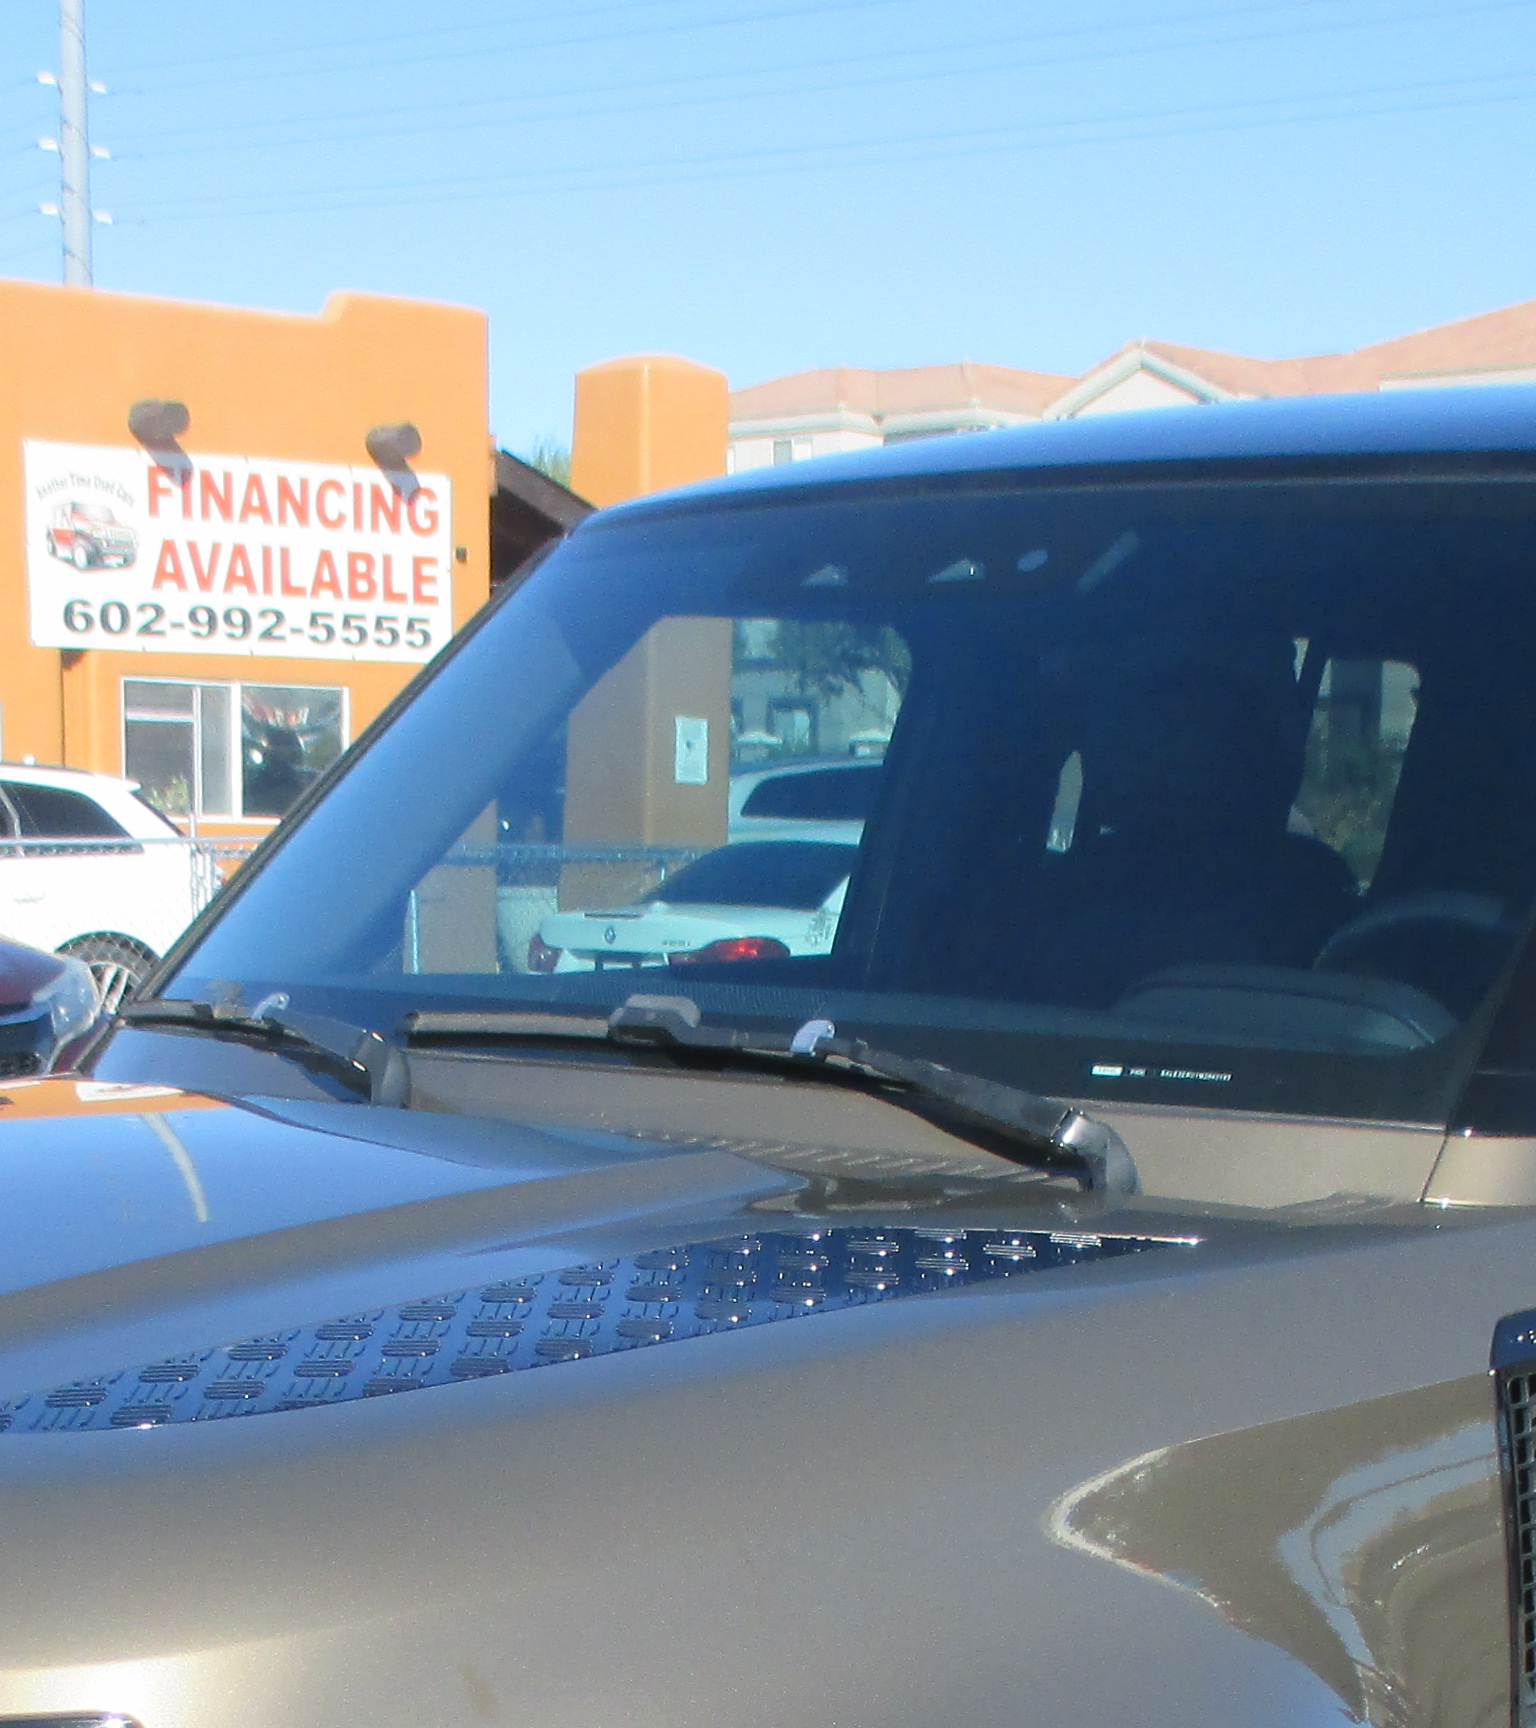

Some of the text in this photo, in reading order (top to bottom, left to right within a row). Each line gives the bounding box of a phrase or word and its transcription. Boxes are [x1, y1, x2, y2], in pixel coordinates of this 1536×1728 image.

[146, 465, 440, 538] FINANCING
[151, 538, 440, 606] AVAILABLE
[62, 598, 433, 650] 602-992-5555
